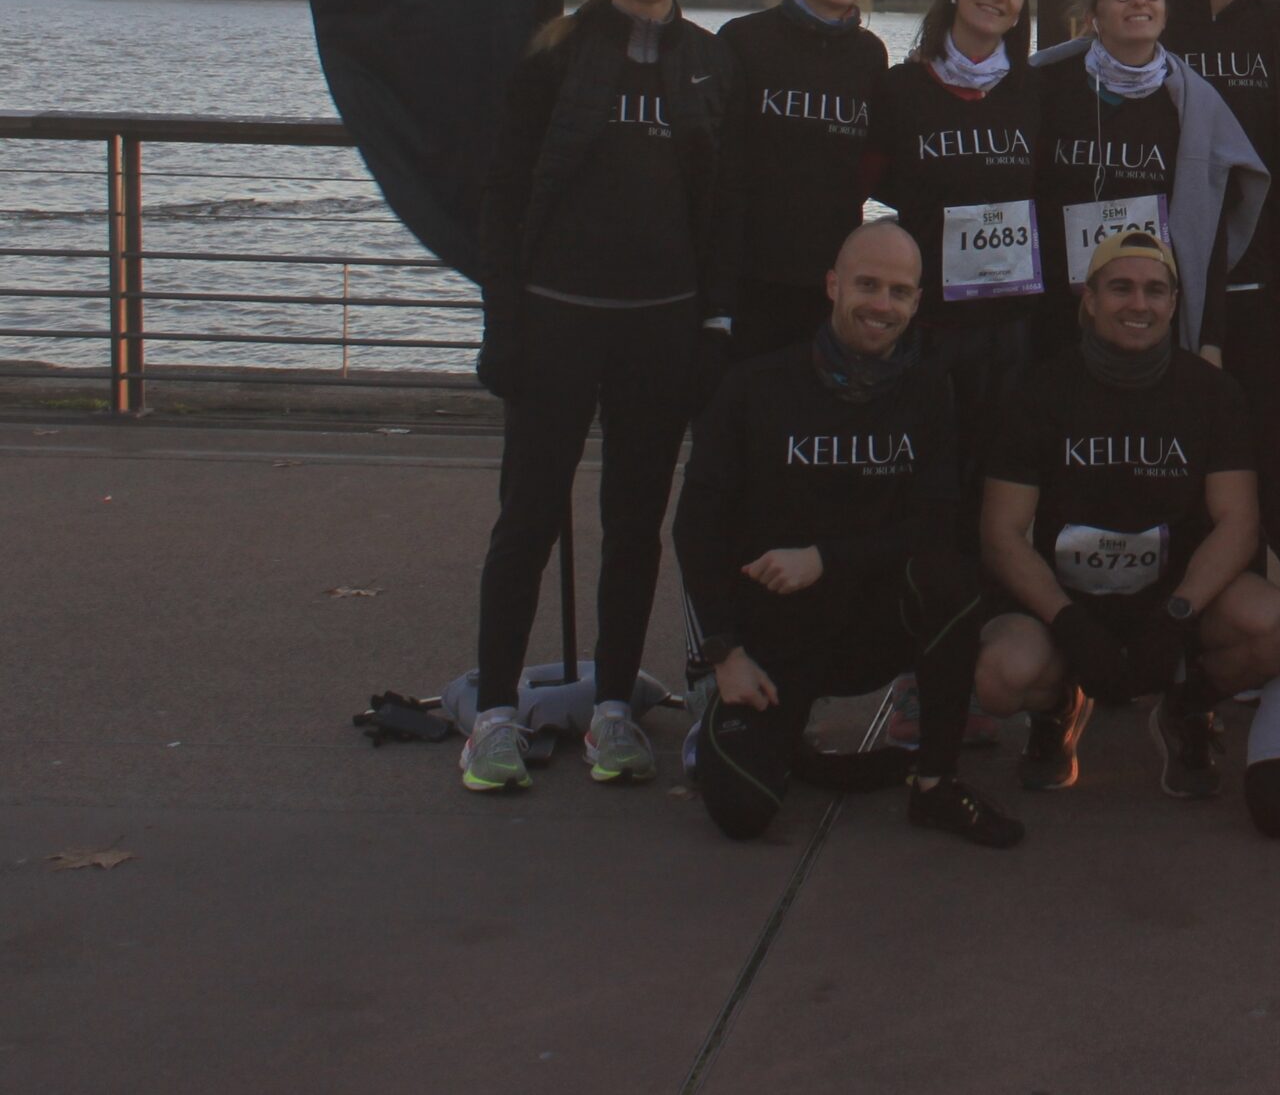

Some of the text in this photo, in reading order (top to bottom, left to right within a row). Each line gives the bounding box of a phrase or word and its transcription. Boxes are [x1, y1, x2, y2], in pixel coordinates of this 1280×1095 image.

[1185, 52, 1268, 78] ELLUA
[761, 88, 869, 127] KELLUA
[919, 129, 1030, 160] KELLUA
[1054, 139, 1166, 171] KELLUA
[983, 211, 1004, 223] SEMI
[1102, 207, 1128, 219] SEMI
[960, 226, 1029, 251] 16683
[787, 433, 915, 465] KELLUA
[1065, 436, 1188, 466] KELLUA
[1099, 538, 1127, 552] SEMI
[1075, 551, 1157, 570] 16720
